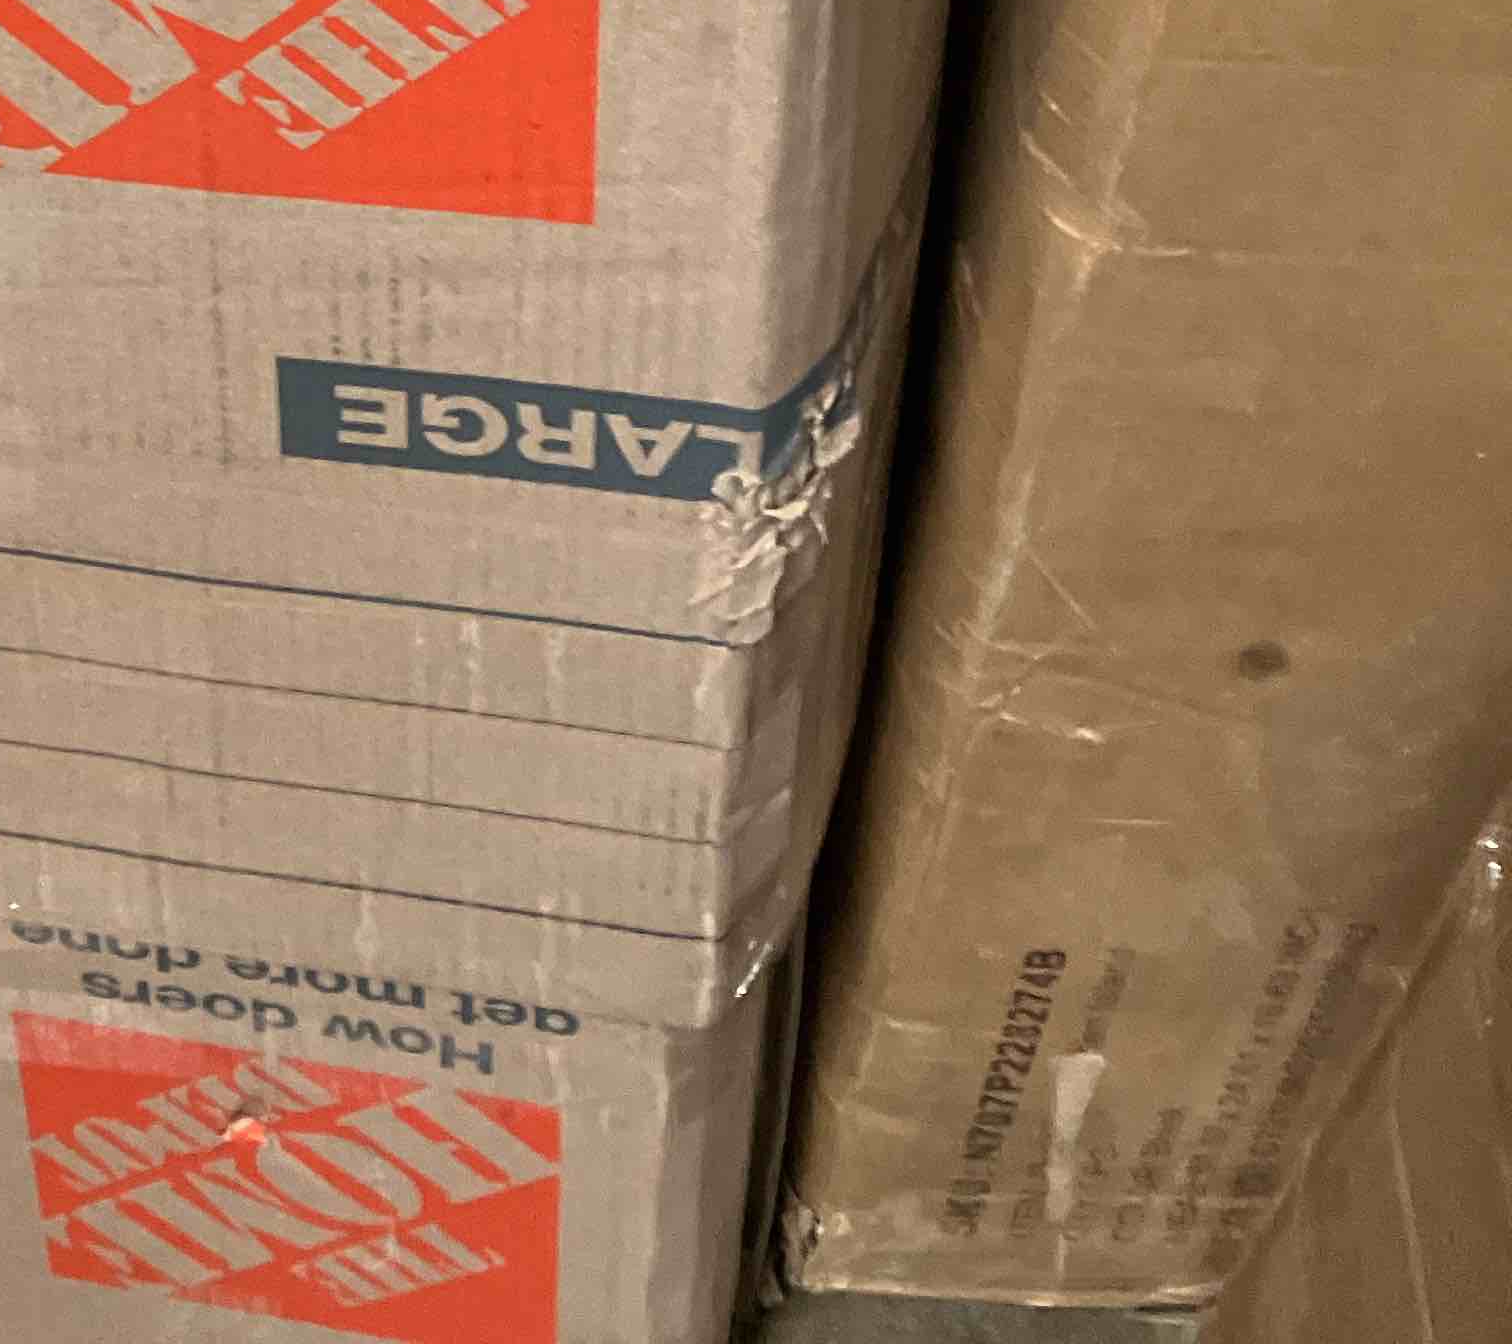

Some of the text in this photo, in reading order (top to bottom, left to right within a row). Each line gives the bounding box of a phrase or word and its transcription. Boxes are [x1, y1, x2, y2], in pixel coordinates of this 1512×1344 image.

[332, 384, 765, 480] LARGE
[80, 970, 497, 1077] How doers
[225, 953, 426, 1011] more
[38, 1082, 560, 1298] HOME
[289, 1223, 505, 1309] THE
